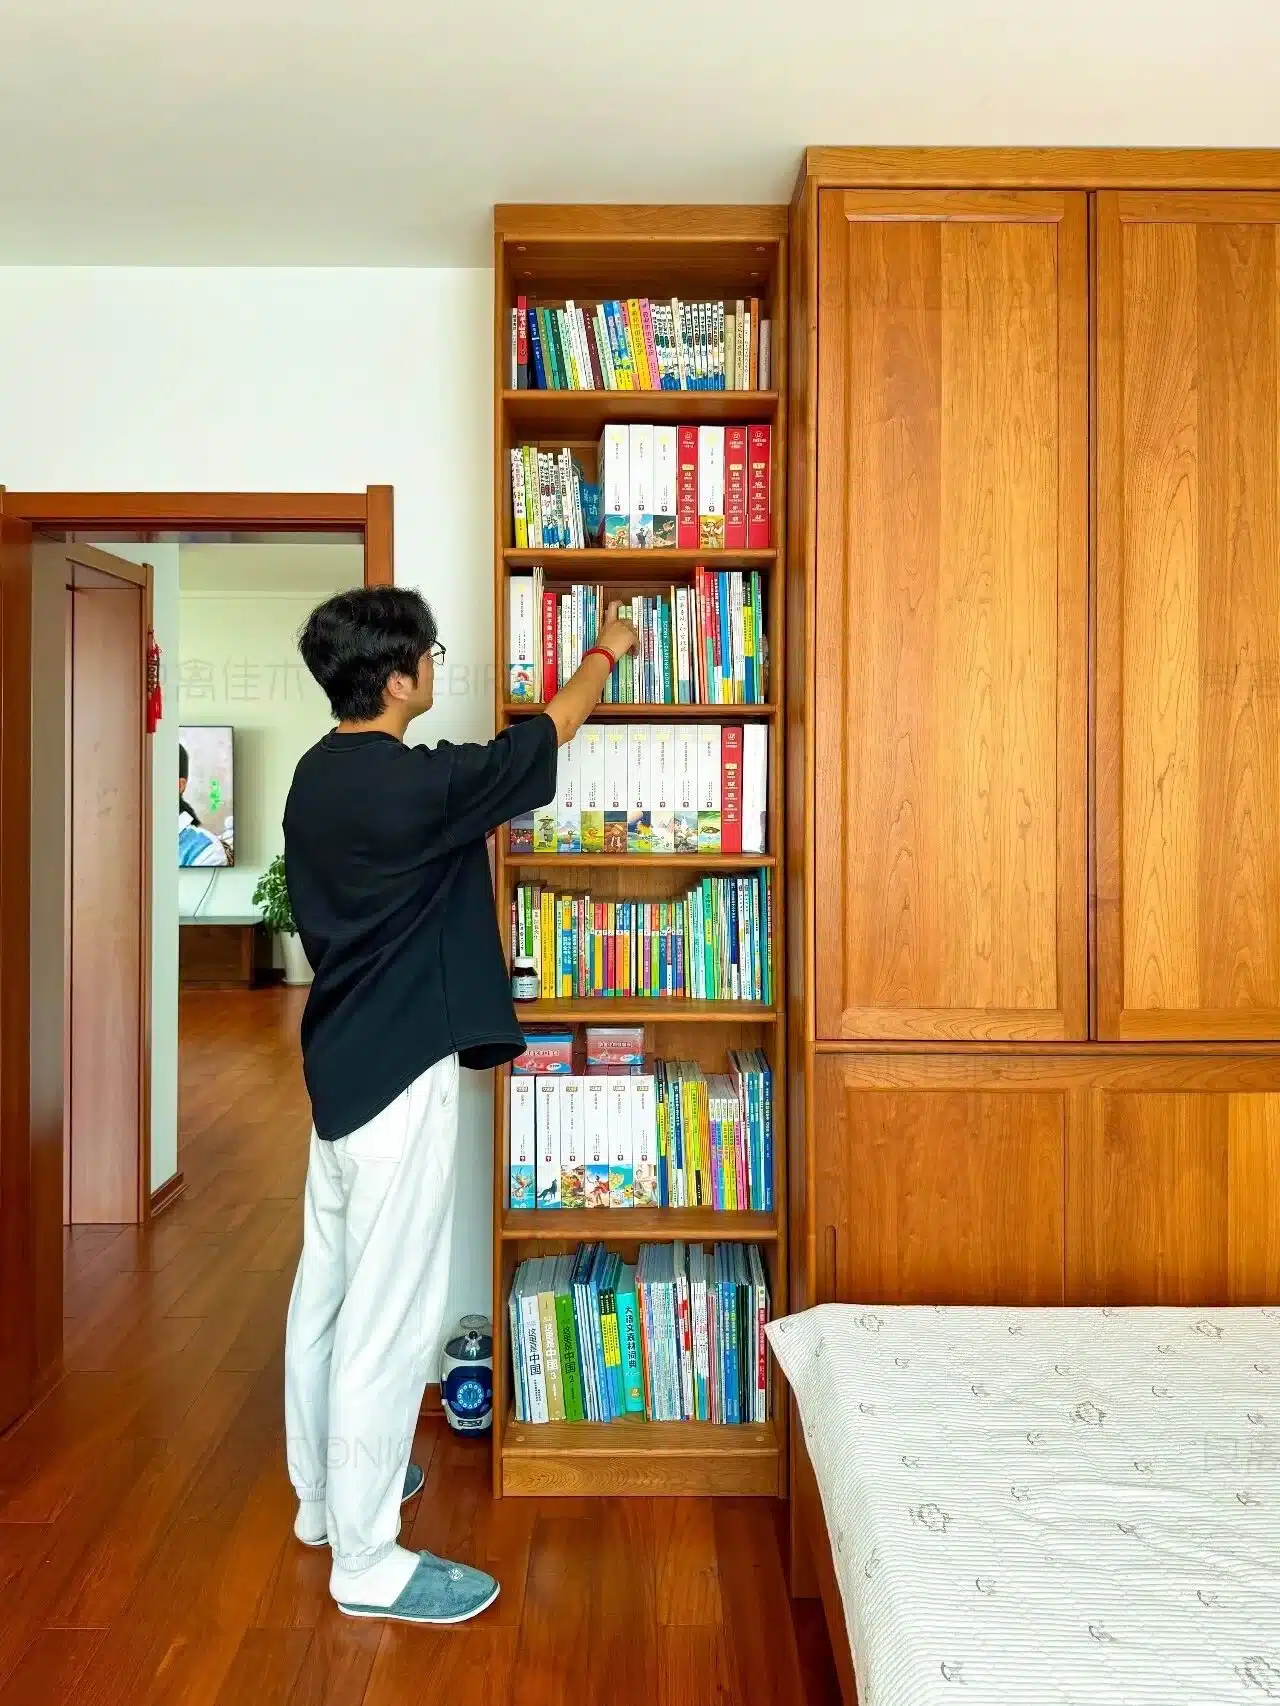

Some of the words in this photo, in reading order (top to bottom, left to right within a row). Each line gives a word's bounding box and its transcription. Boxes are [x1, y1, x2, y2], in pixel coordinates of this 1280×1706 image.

[624, 1306, 638, 1369] 大语文素材词典
